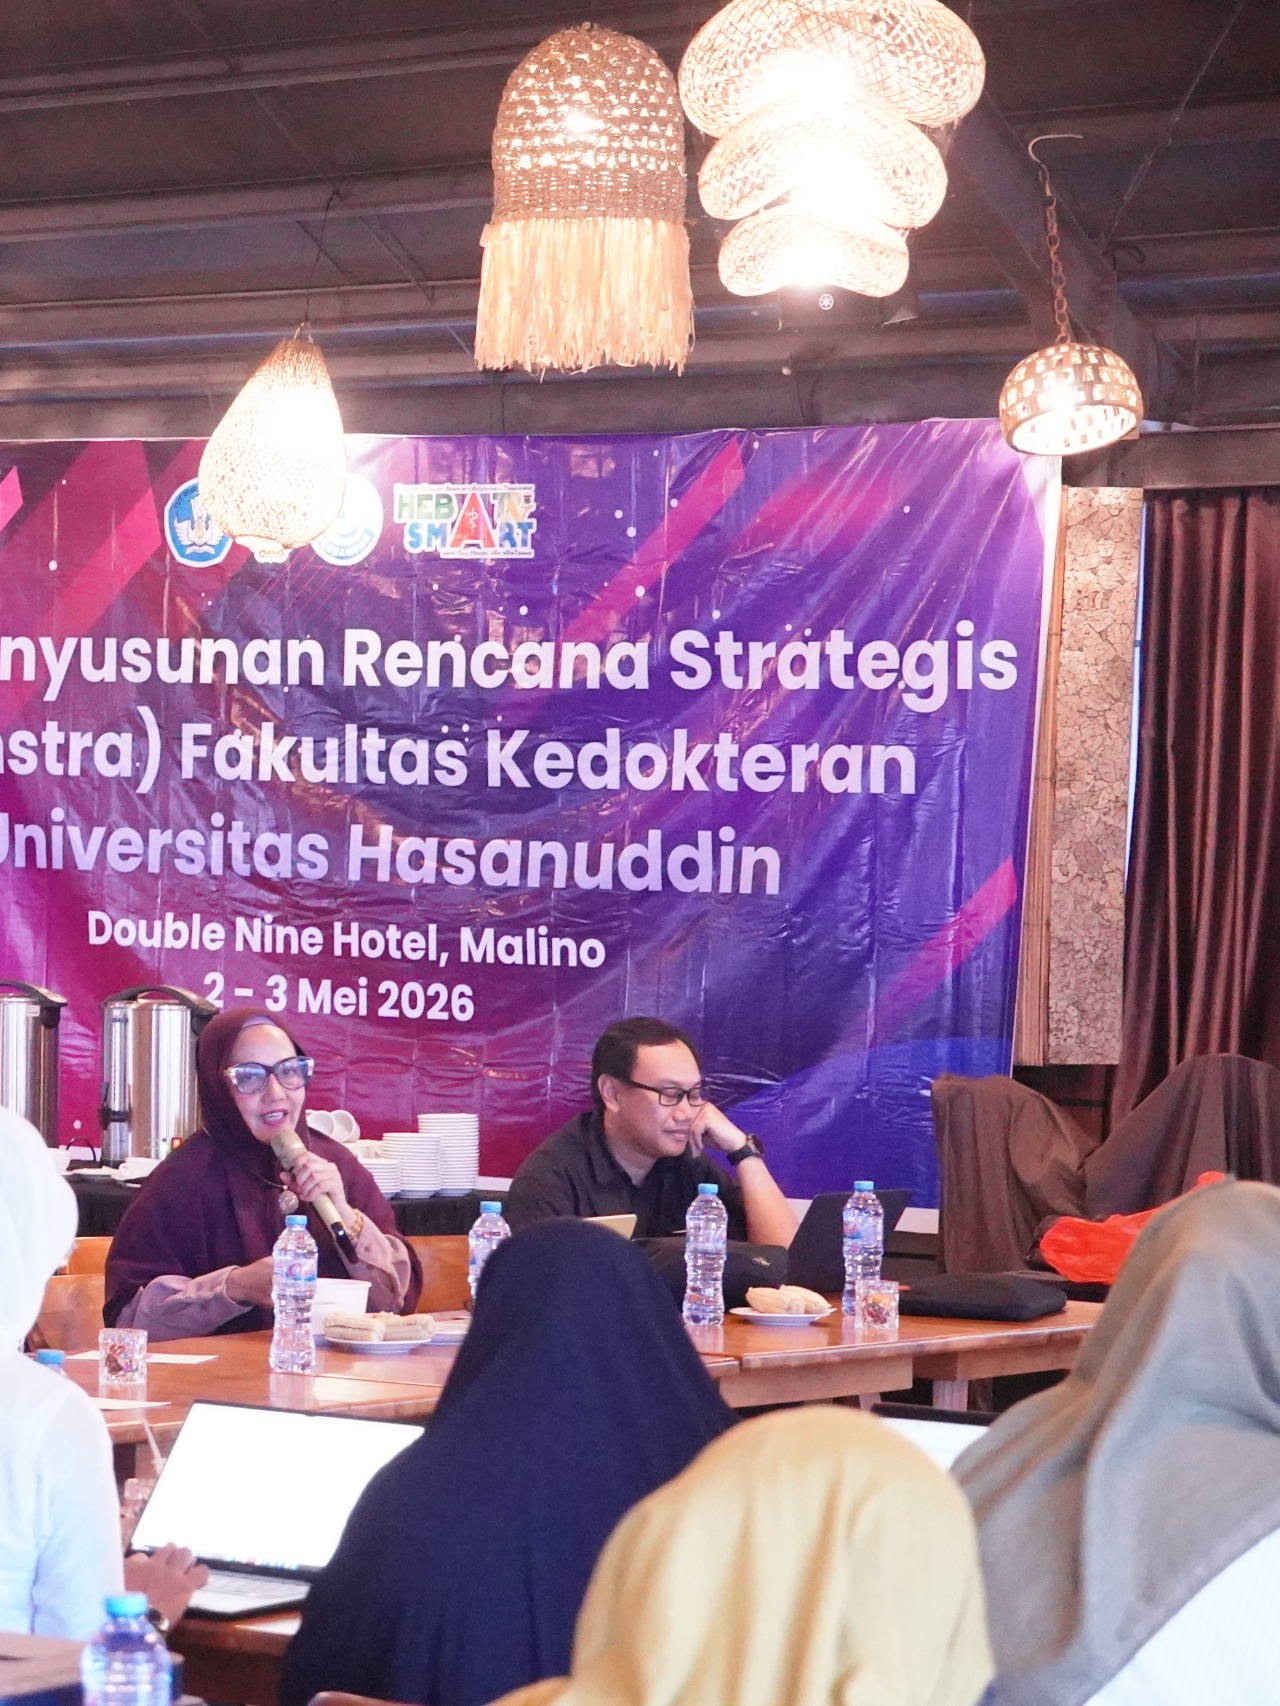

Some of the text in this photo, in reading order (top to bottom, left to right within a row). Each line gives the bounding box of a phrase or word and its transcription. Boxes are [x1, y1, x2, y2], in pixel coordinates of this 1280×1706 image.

[343, 628, 651, 690] Rencana
[669, 619, 1019, 713] Strategis
[181, 722, 468, 787] Fakultas
[487, 728, 916, 795] Kedokteran
[348, 823, 781, 895] Hasanuddin
[88, 910, 606, 968] Double Nine Hotel, Malino
[203, 971, 225, 1009] 2
[265, 974, 288, 1013] 3
[297, 976, 368, 1016] Mei
[377, 980, 475, 1022] 2026
